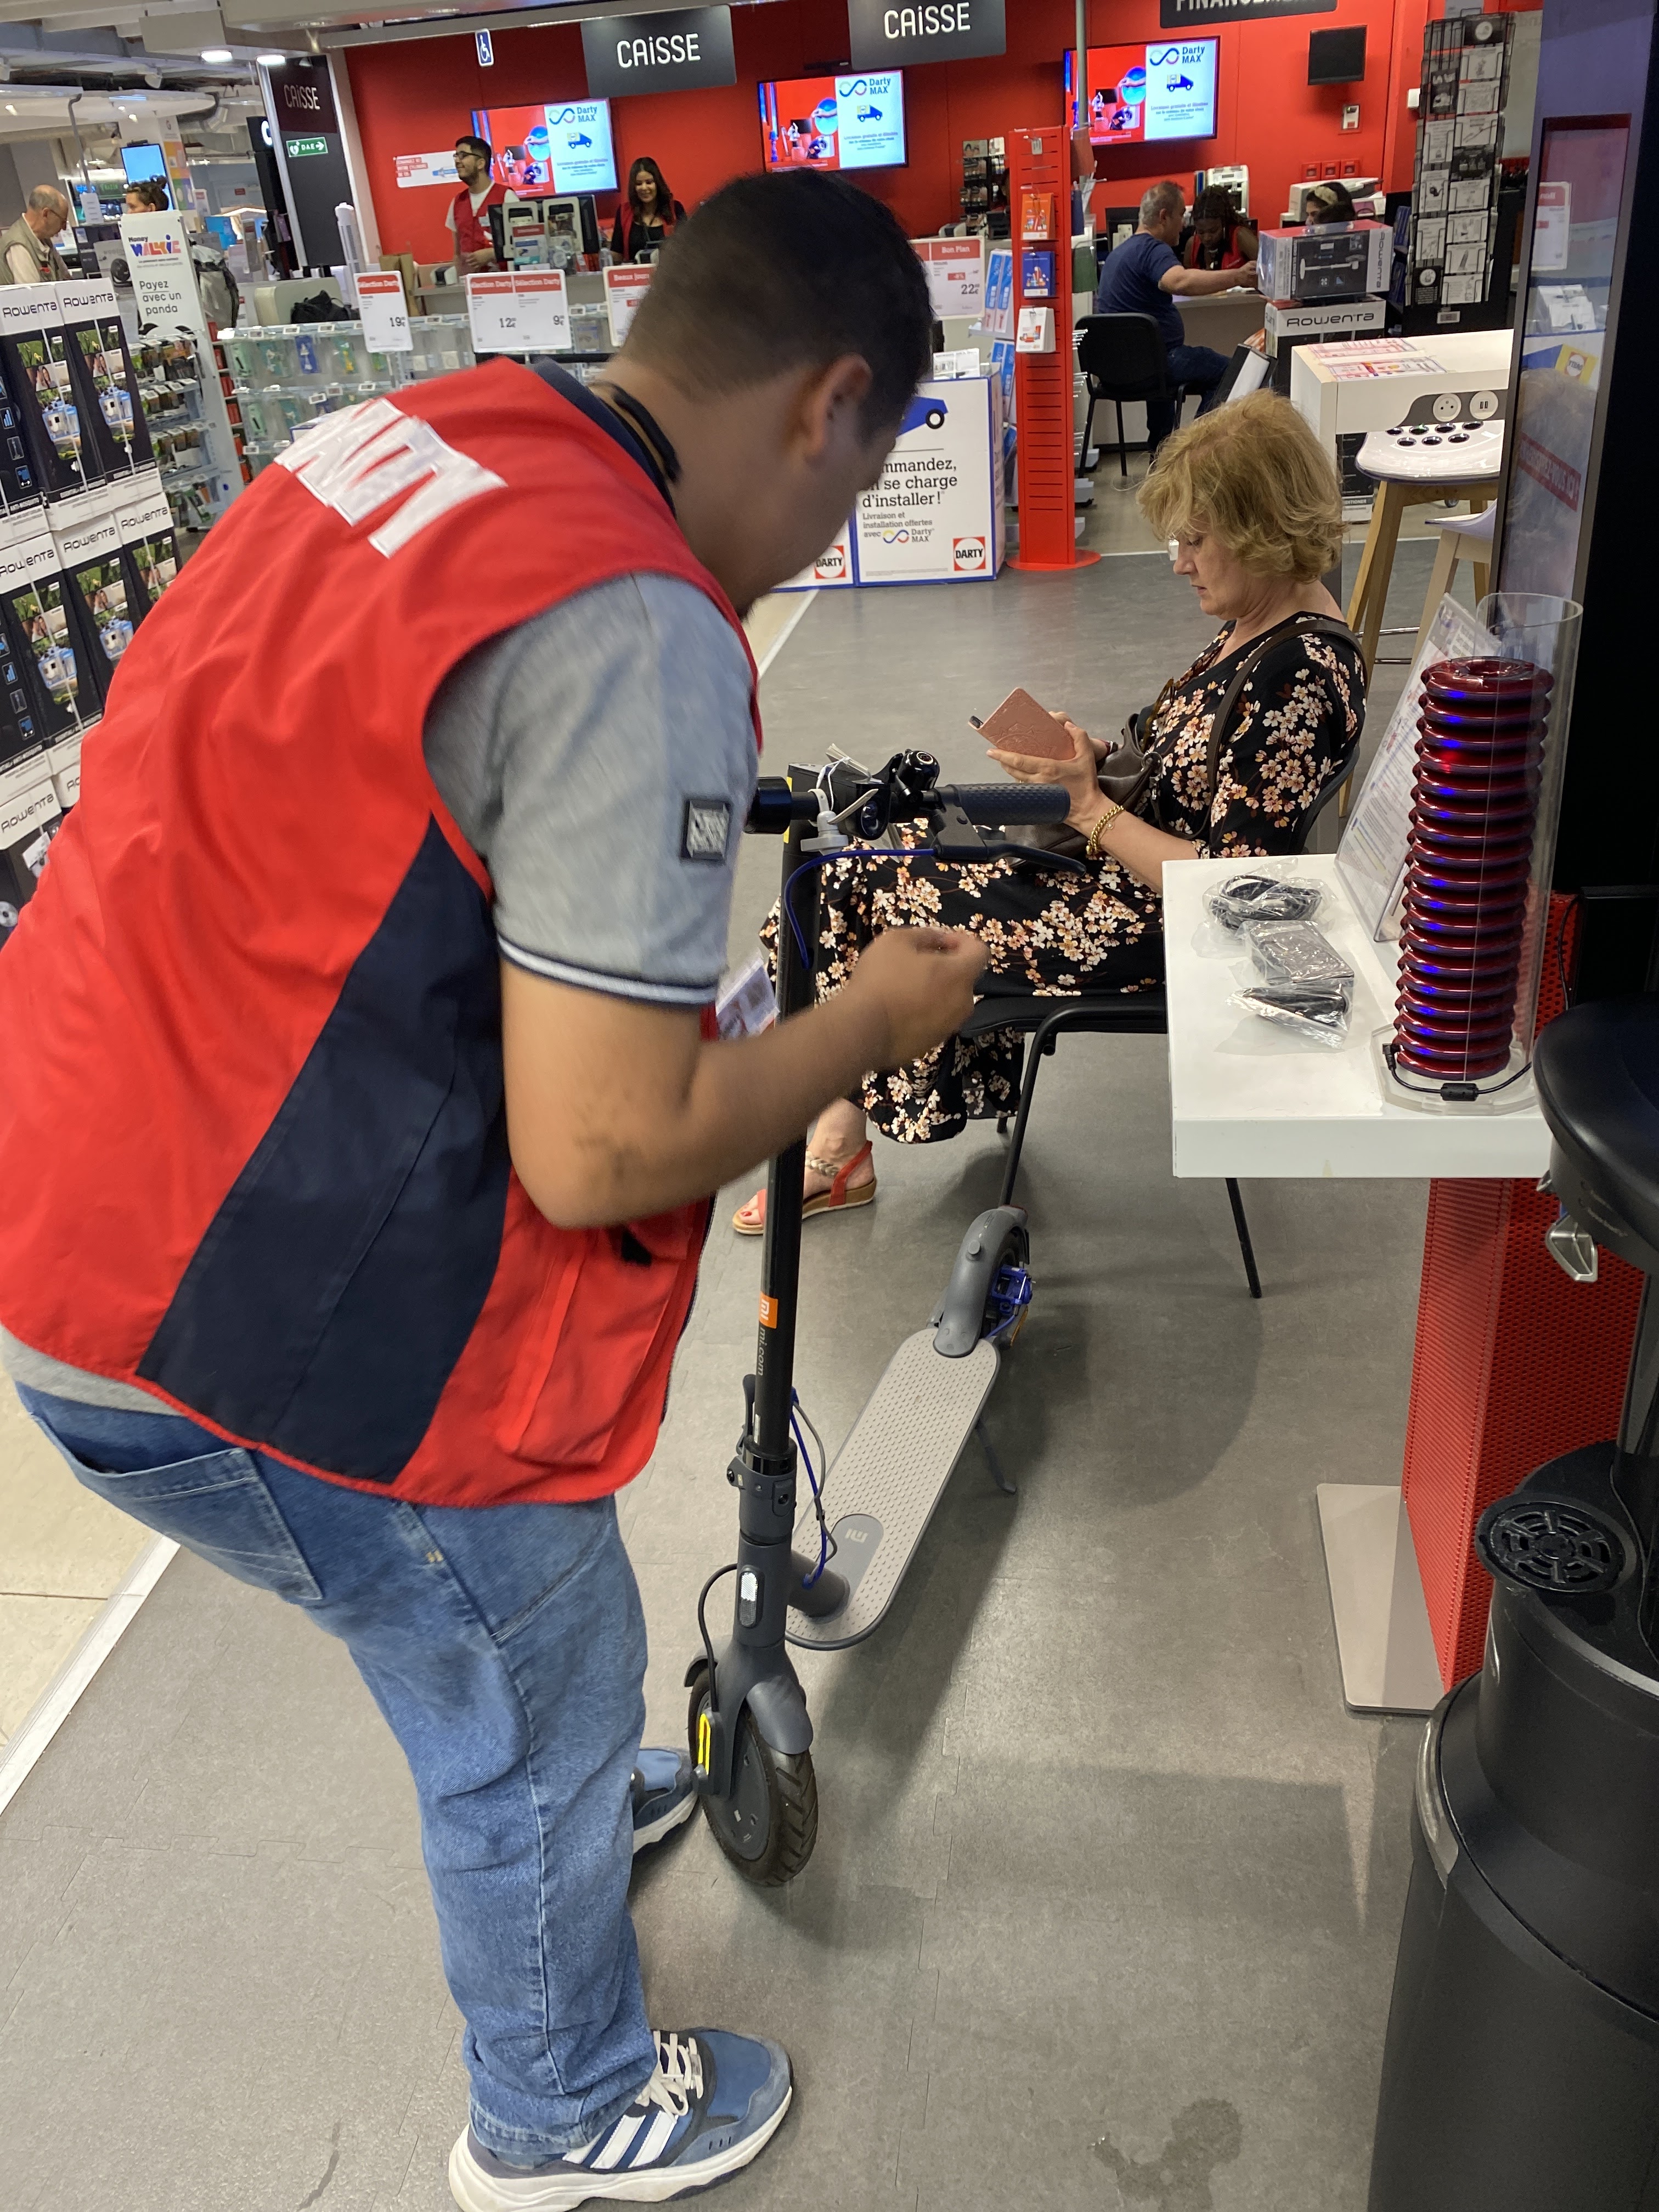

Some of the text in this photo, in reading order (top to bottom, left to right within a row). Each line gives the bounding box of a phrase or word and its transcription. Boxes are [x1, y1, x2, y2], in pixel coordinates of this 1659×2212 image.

[1182, 46, 1205, 54] Darty
[1182, 55, 1201, 64] MAX
[870, 77, 891, 86] Darty
[870, 86, 888, 94] MAX
[577, 106, 597, 114] Darty
[139, 280, 169, 291] Payez
[143, 294, 166, 302] avec
[145, 304, 178, 317] panda
[882, 458, 957, 473] mmandez,
[884, 479, 900, 490] se
[905, 475, 958, 490] charge
[863, 519, 933, 529] installation offertes
[956, 549, 984, 559] DARTY
[758, 1327, 768, 1376] mi.com
